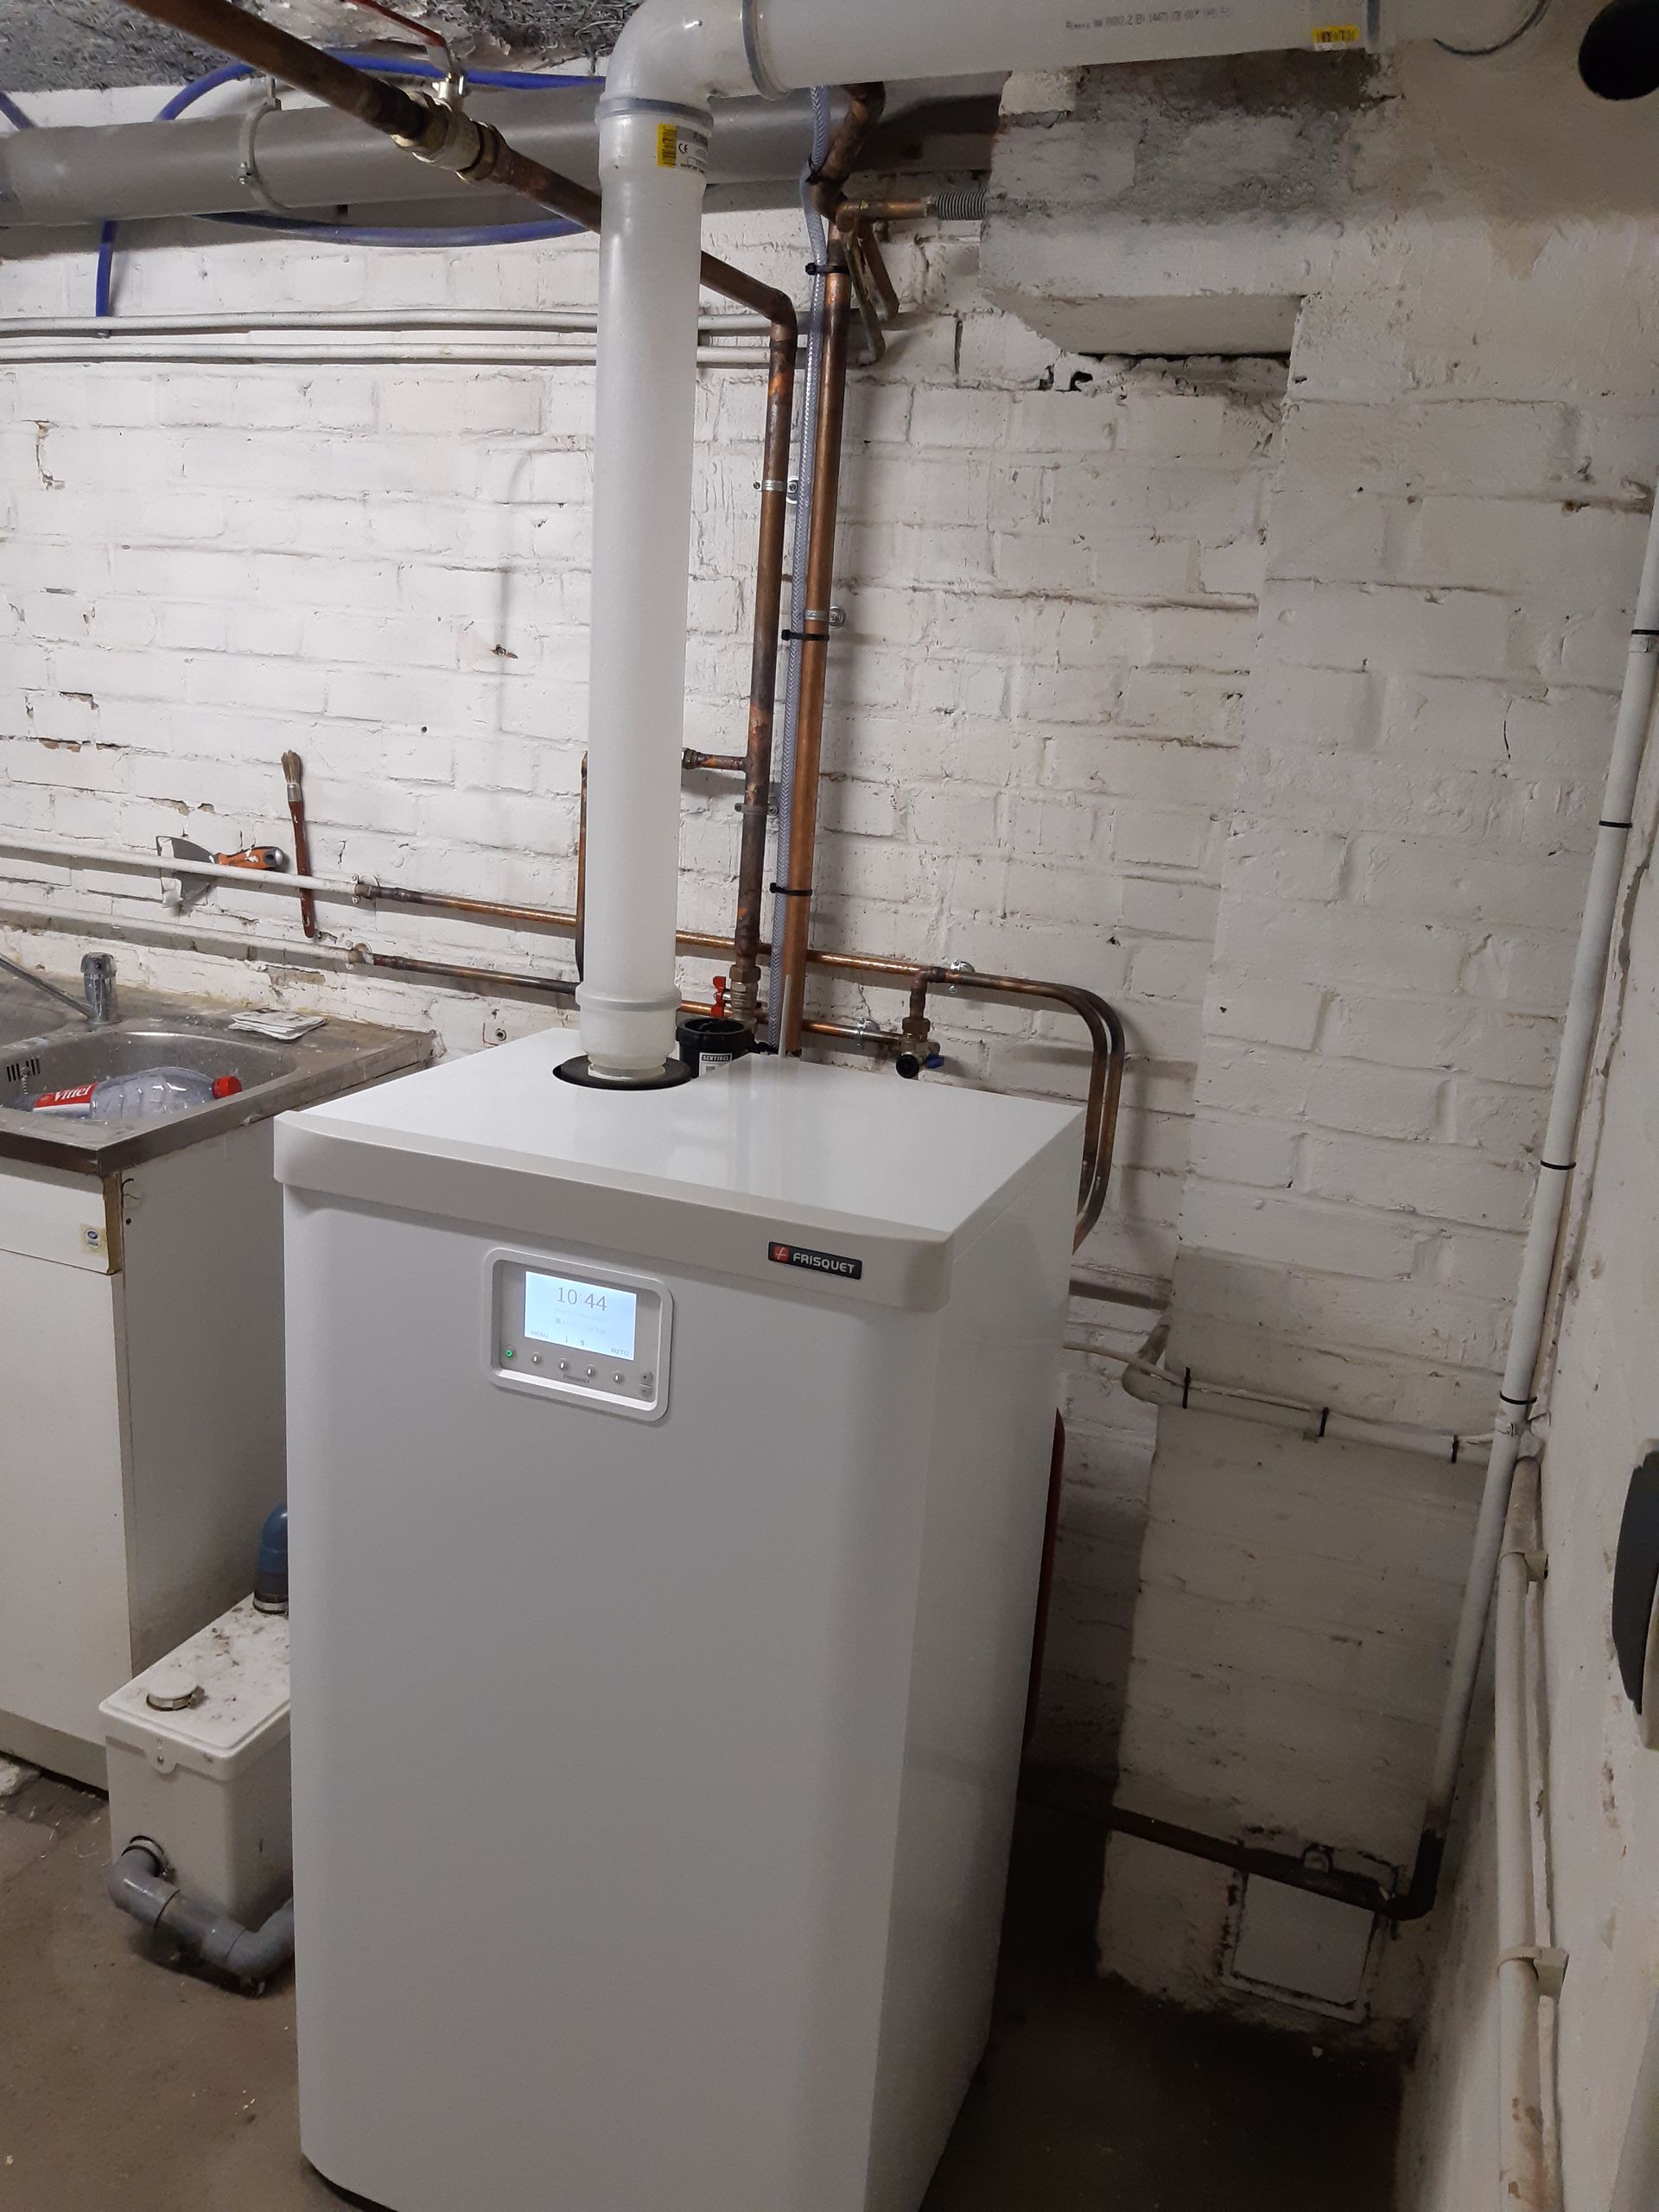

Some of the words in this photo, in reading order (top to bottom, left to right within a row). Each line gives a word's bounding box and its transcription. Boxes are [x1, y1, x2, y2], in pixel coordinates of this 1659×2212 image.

[54, 1084, 92, 1102] Vittel
[792, 1252, 855, 1274] FRISQUET
[610, 1347, 630, 1357] AUTO
